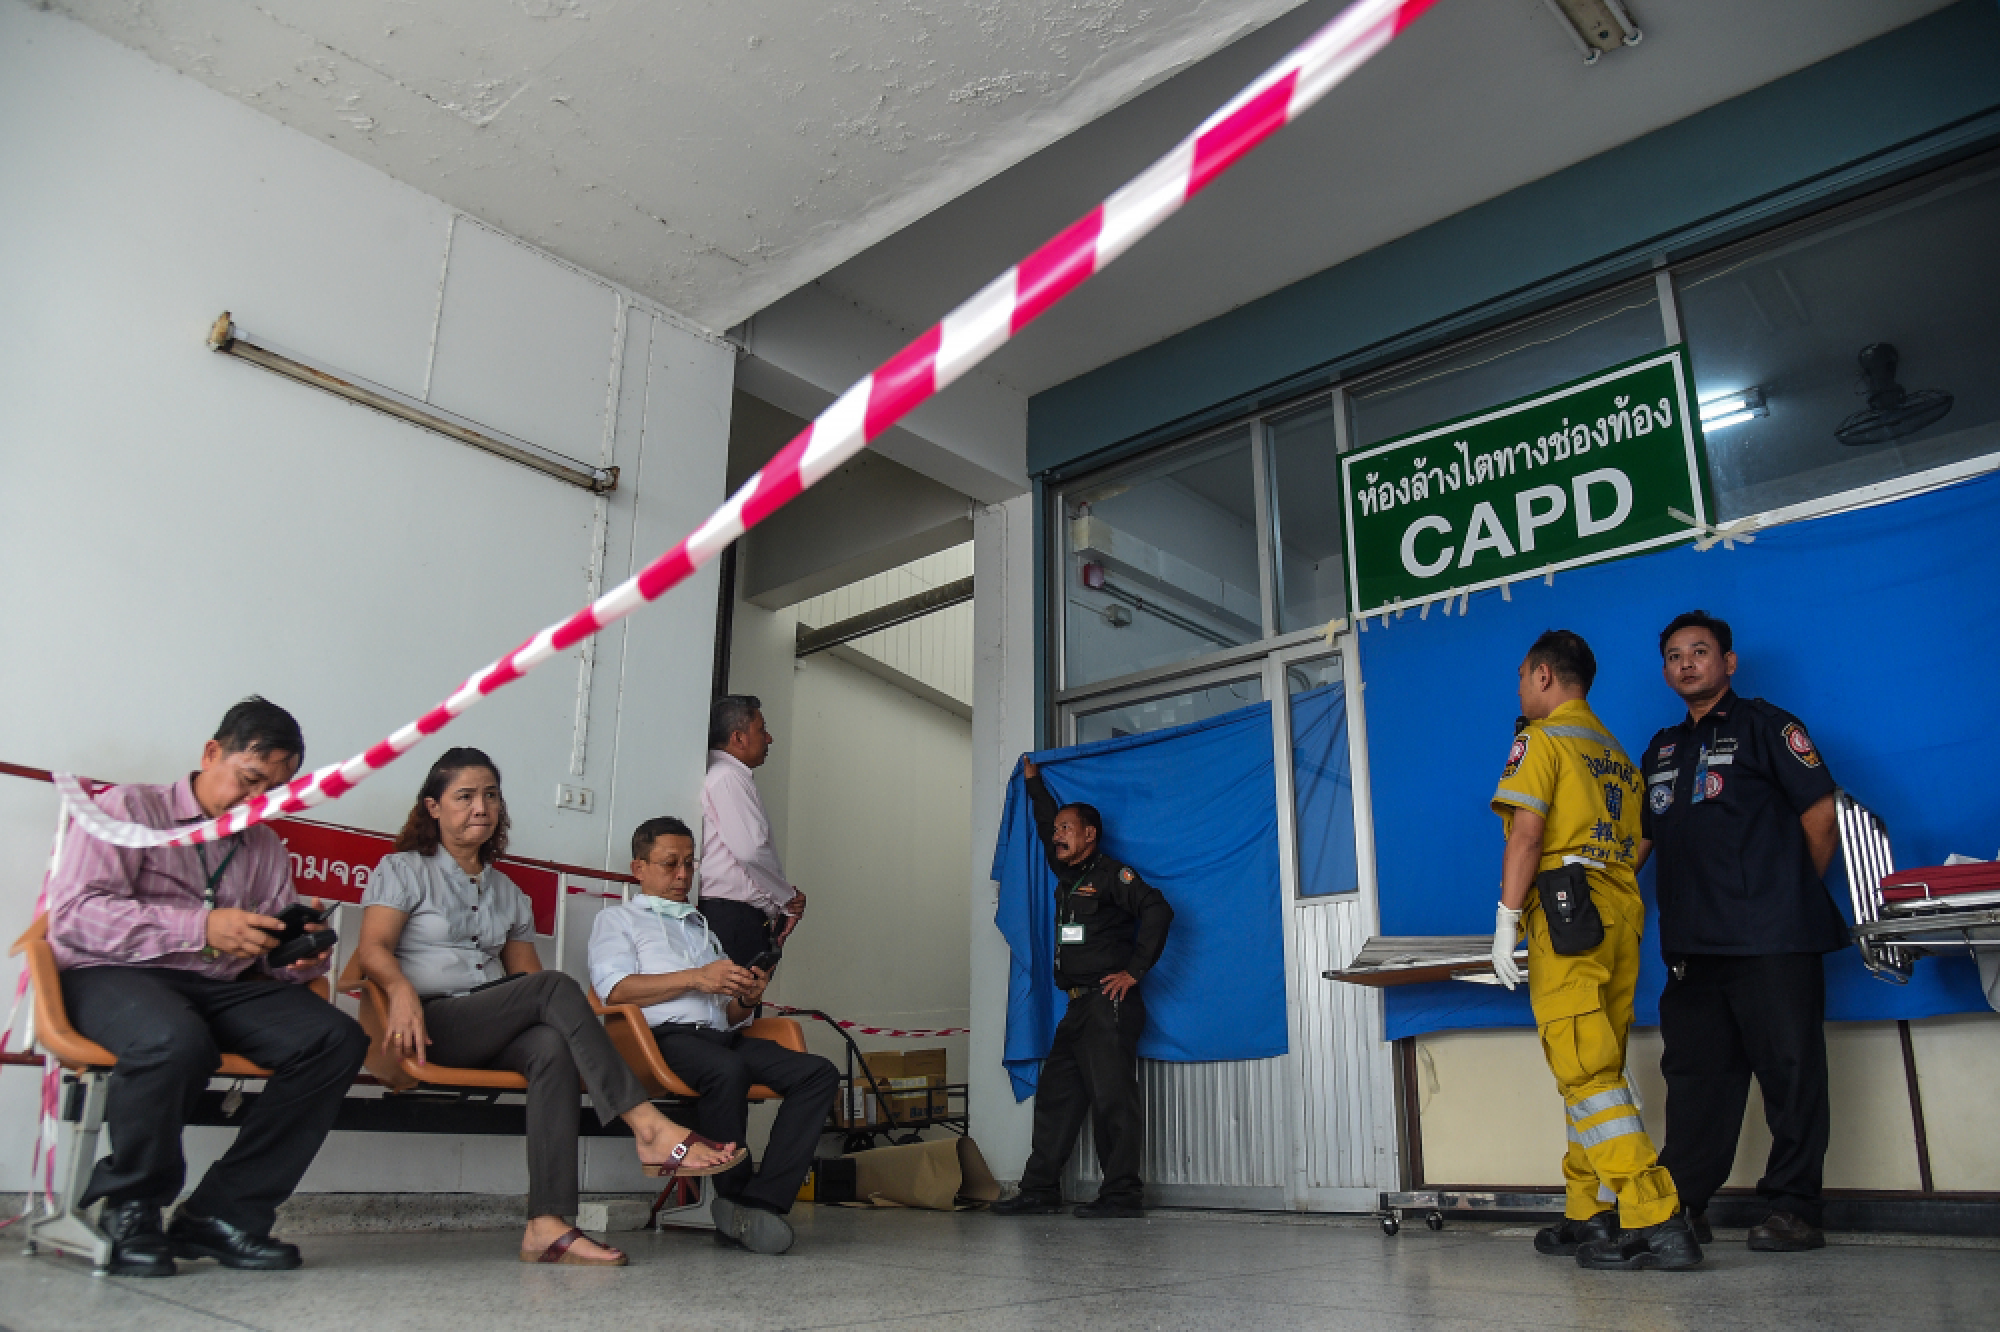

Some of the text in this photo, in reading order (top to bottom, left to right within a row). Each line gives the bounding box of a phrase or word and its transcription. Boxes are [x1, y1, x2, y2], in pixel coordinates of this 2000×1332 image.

[1357, 394, 1673, 517] ห้องล้างไตทางช่องท้อง
[1400, 467, 1633, 578] CAPD
